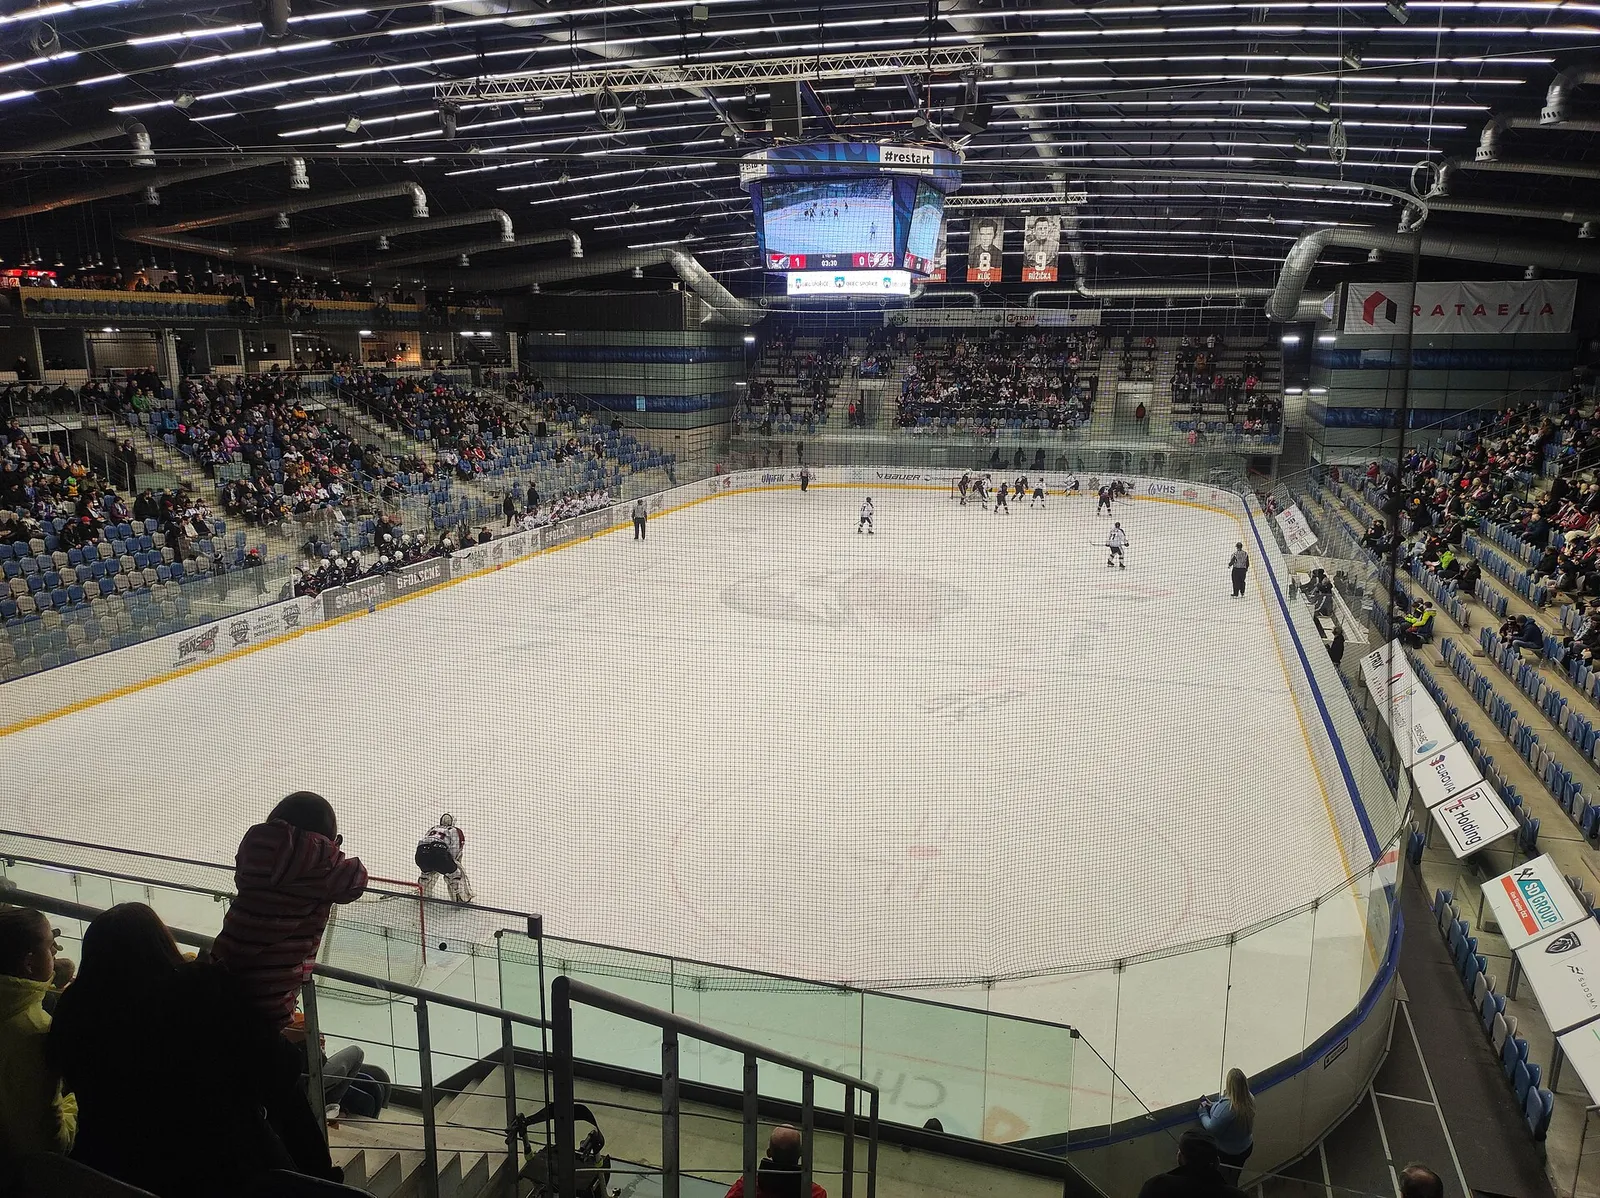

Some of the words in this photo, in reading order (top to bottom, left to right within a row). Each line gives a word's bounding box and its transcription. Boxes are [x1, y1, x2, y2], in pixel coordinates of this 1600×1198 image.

[885, 151, 931, 165] #restart
[795, 257, 801, 267] 1
[859, 256, 865, 266] 0
[980, 252, 991, 271] 8
[1035, 252, 1047, 271] 9
[1410, 303, 1555, 317] RATAELA
[1157, 483, 1176, 494] VHS
[177, 626, 220, 658] FANSHOP
[1368, 651, 1385, 672] STRIX
[1435, 763, 1456, 794] EUROVIA
[1454, 809, 1482, 845] Holding
[1524, 881, 1540, 896] SD
[1531, 895, 1558, 925] GROUP
